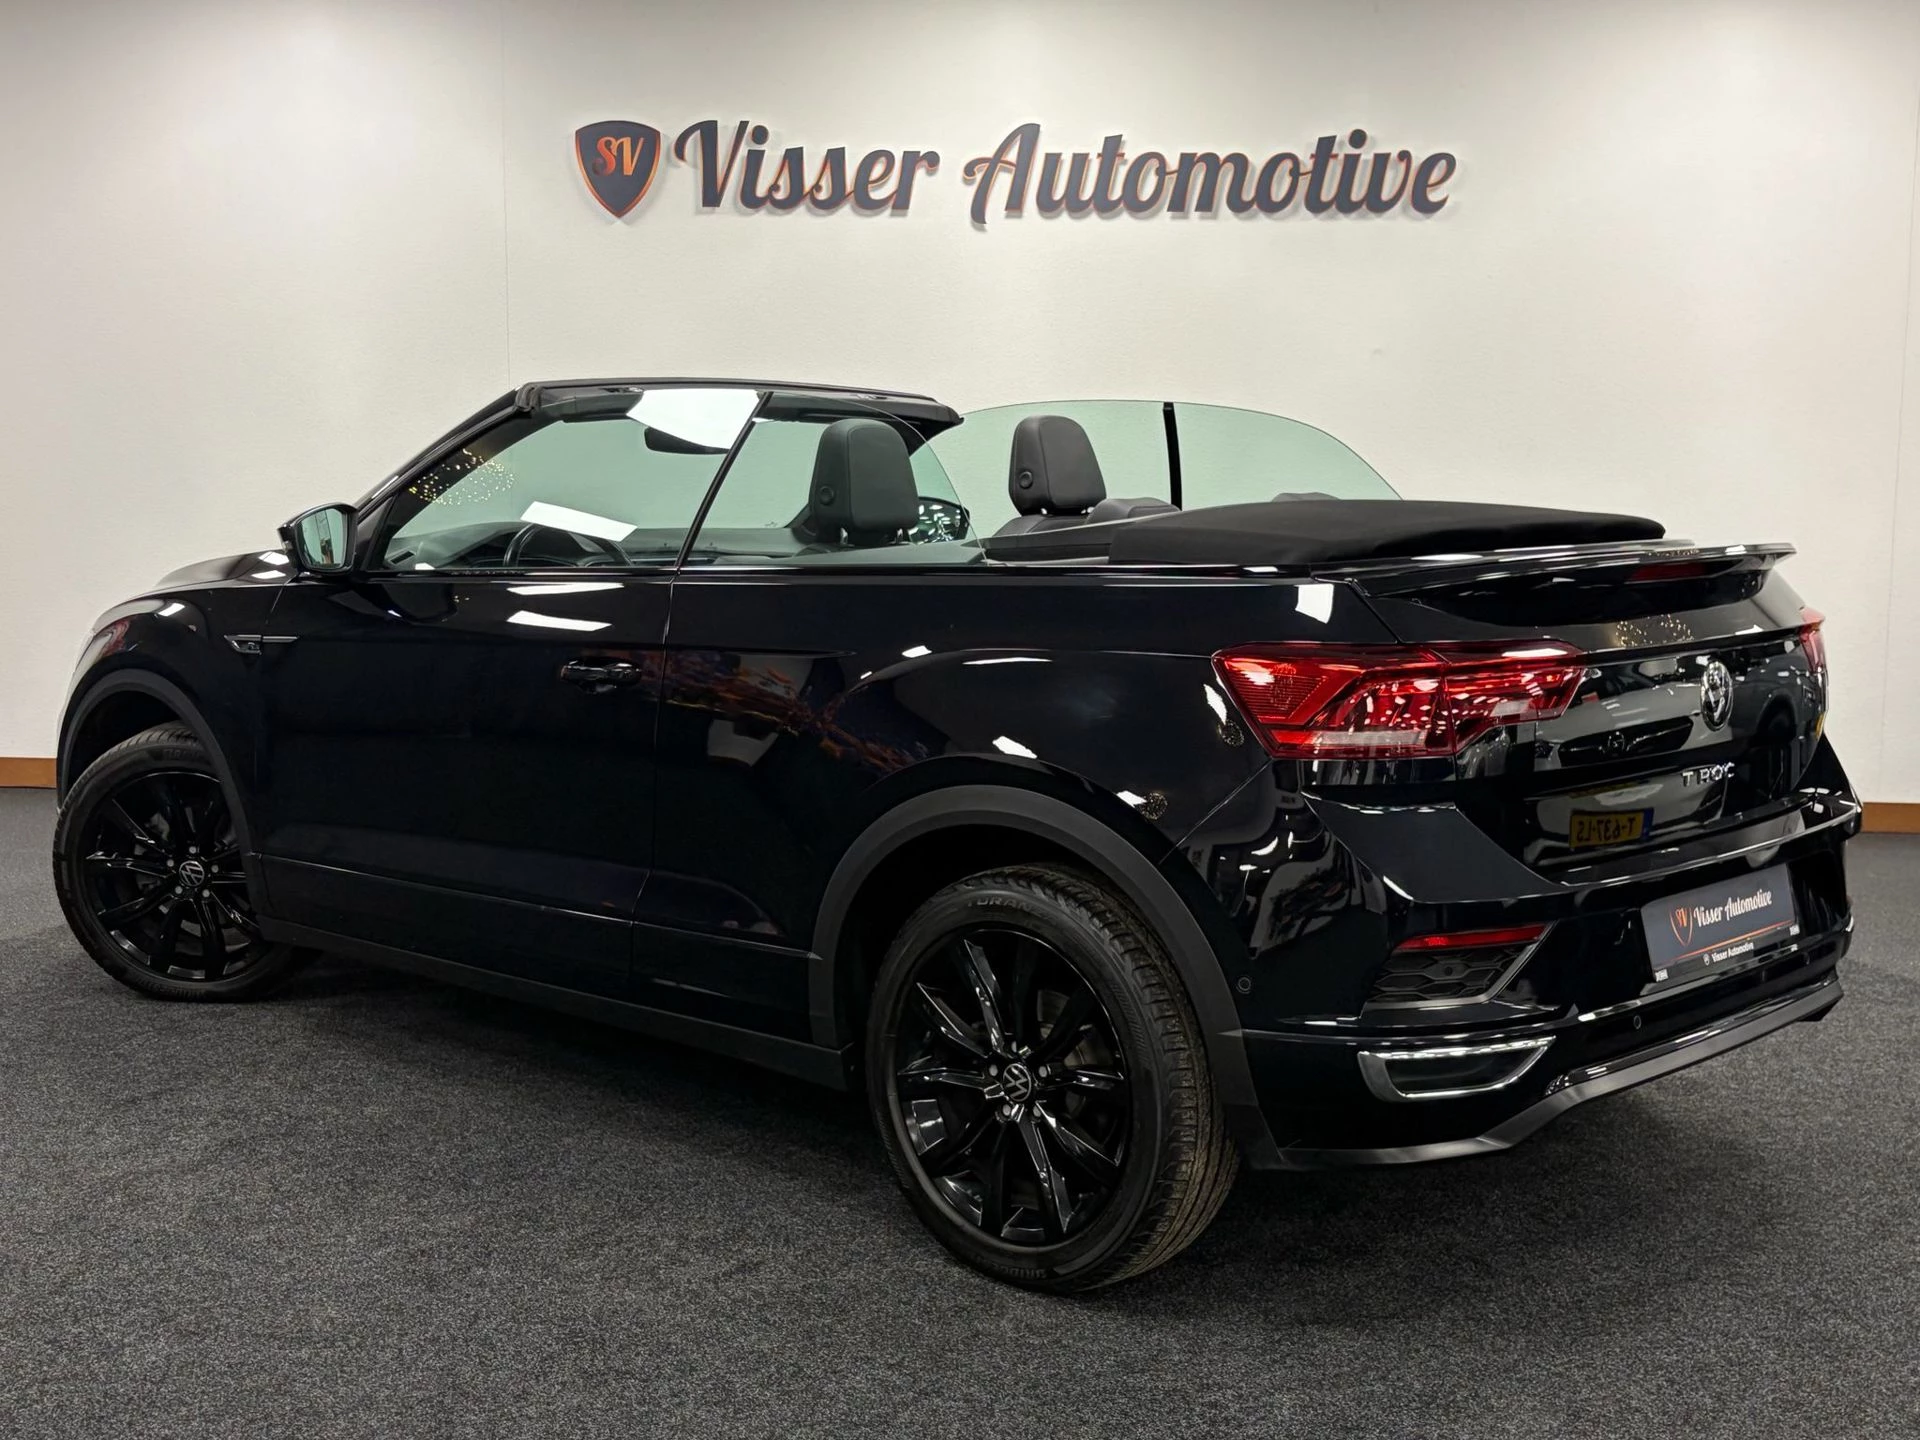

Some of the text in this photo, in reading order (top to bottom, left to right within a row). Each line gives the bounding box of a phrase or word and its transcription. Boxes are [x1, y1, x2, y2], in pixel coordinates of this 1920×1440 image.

[592, 136, 645, 176] SV
[674, 120, 1457, 225] Visser Automotive
[1694, 890, 1772, 927] Visser Automotive
